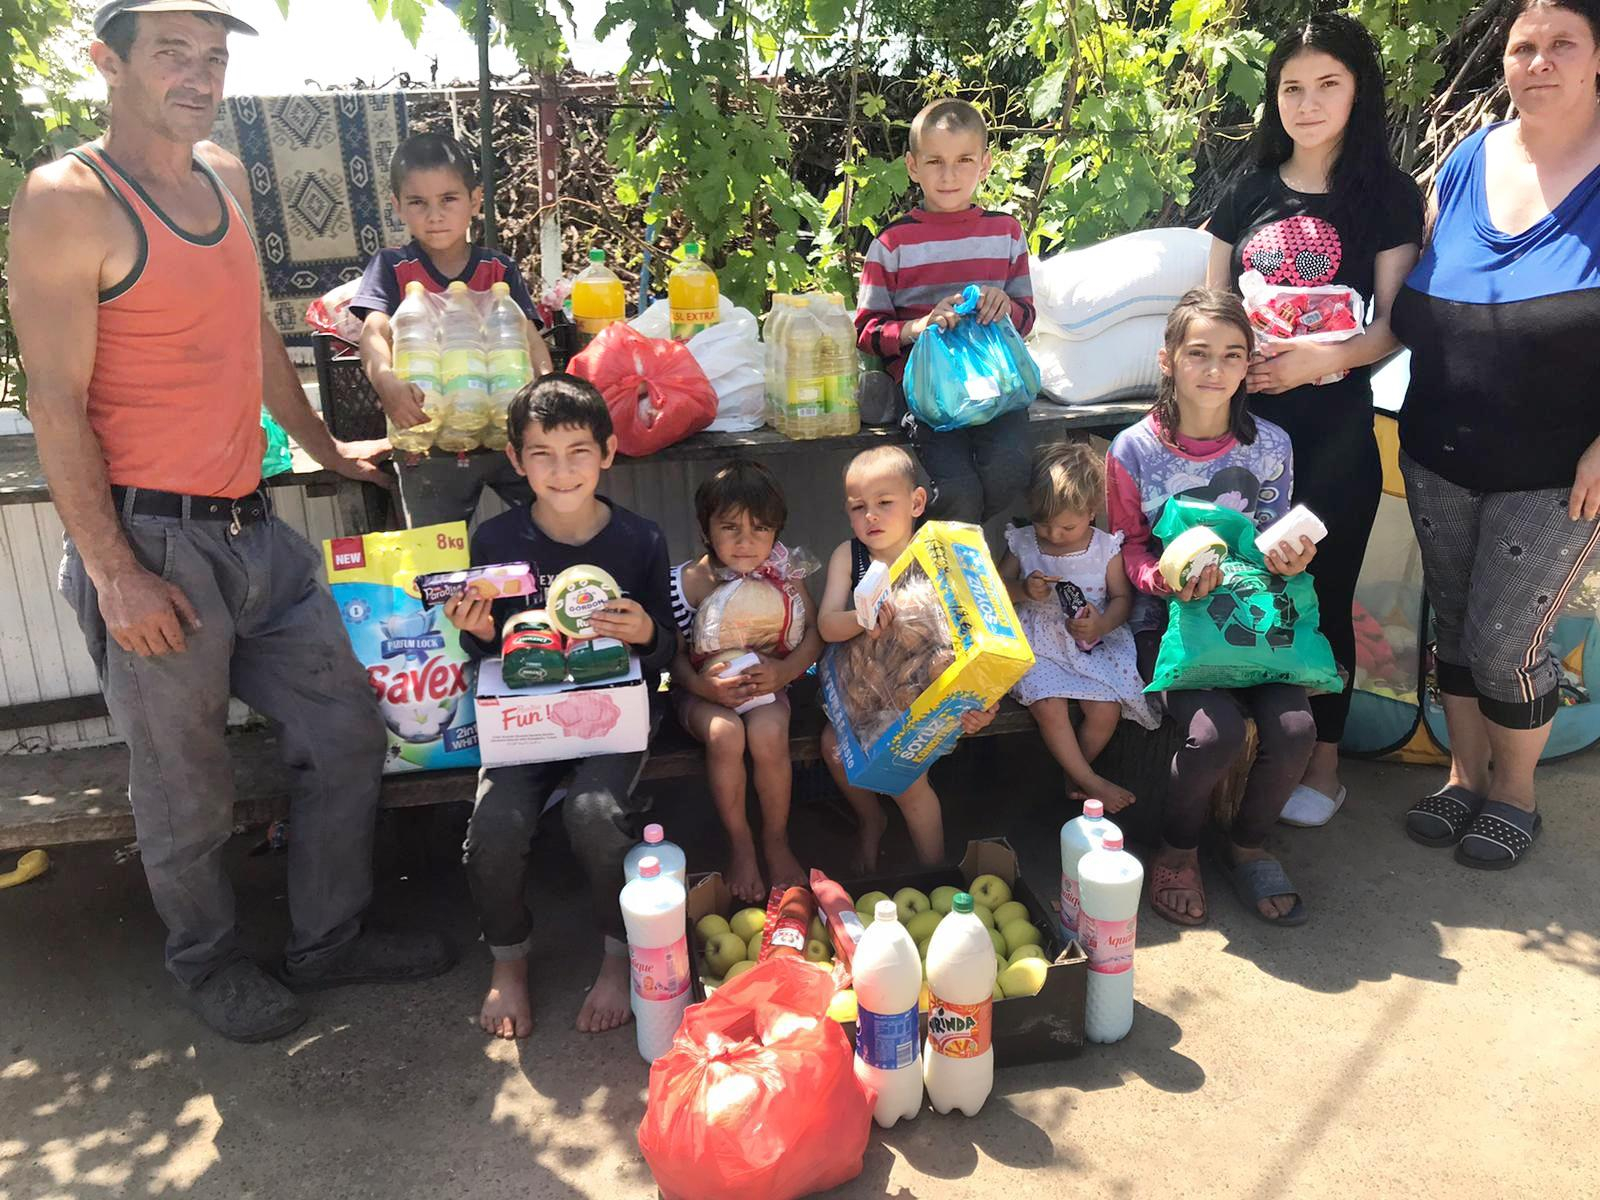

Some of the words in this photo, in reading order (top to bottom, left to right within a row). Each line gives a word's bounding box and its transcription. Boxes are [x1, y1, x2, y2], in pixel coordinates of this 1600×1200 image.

[436, 533, 465, 550] 8kg
[335, 552, 361, 566] NEW
[967, 575, 997, 624] SOYUZ
[387, 640, 415, 650] PARFUM
[416, 639, 439, 649] LOCK
[452, 735, 479, 750] WHIT
[900, 719, 945, 760] SOYUZ
